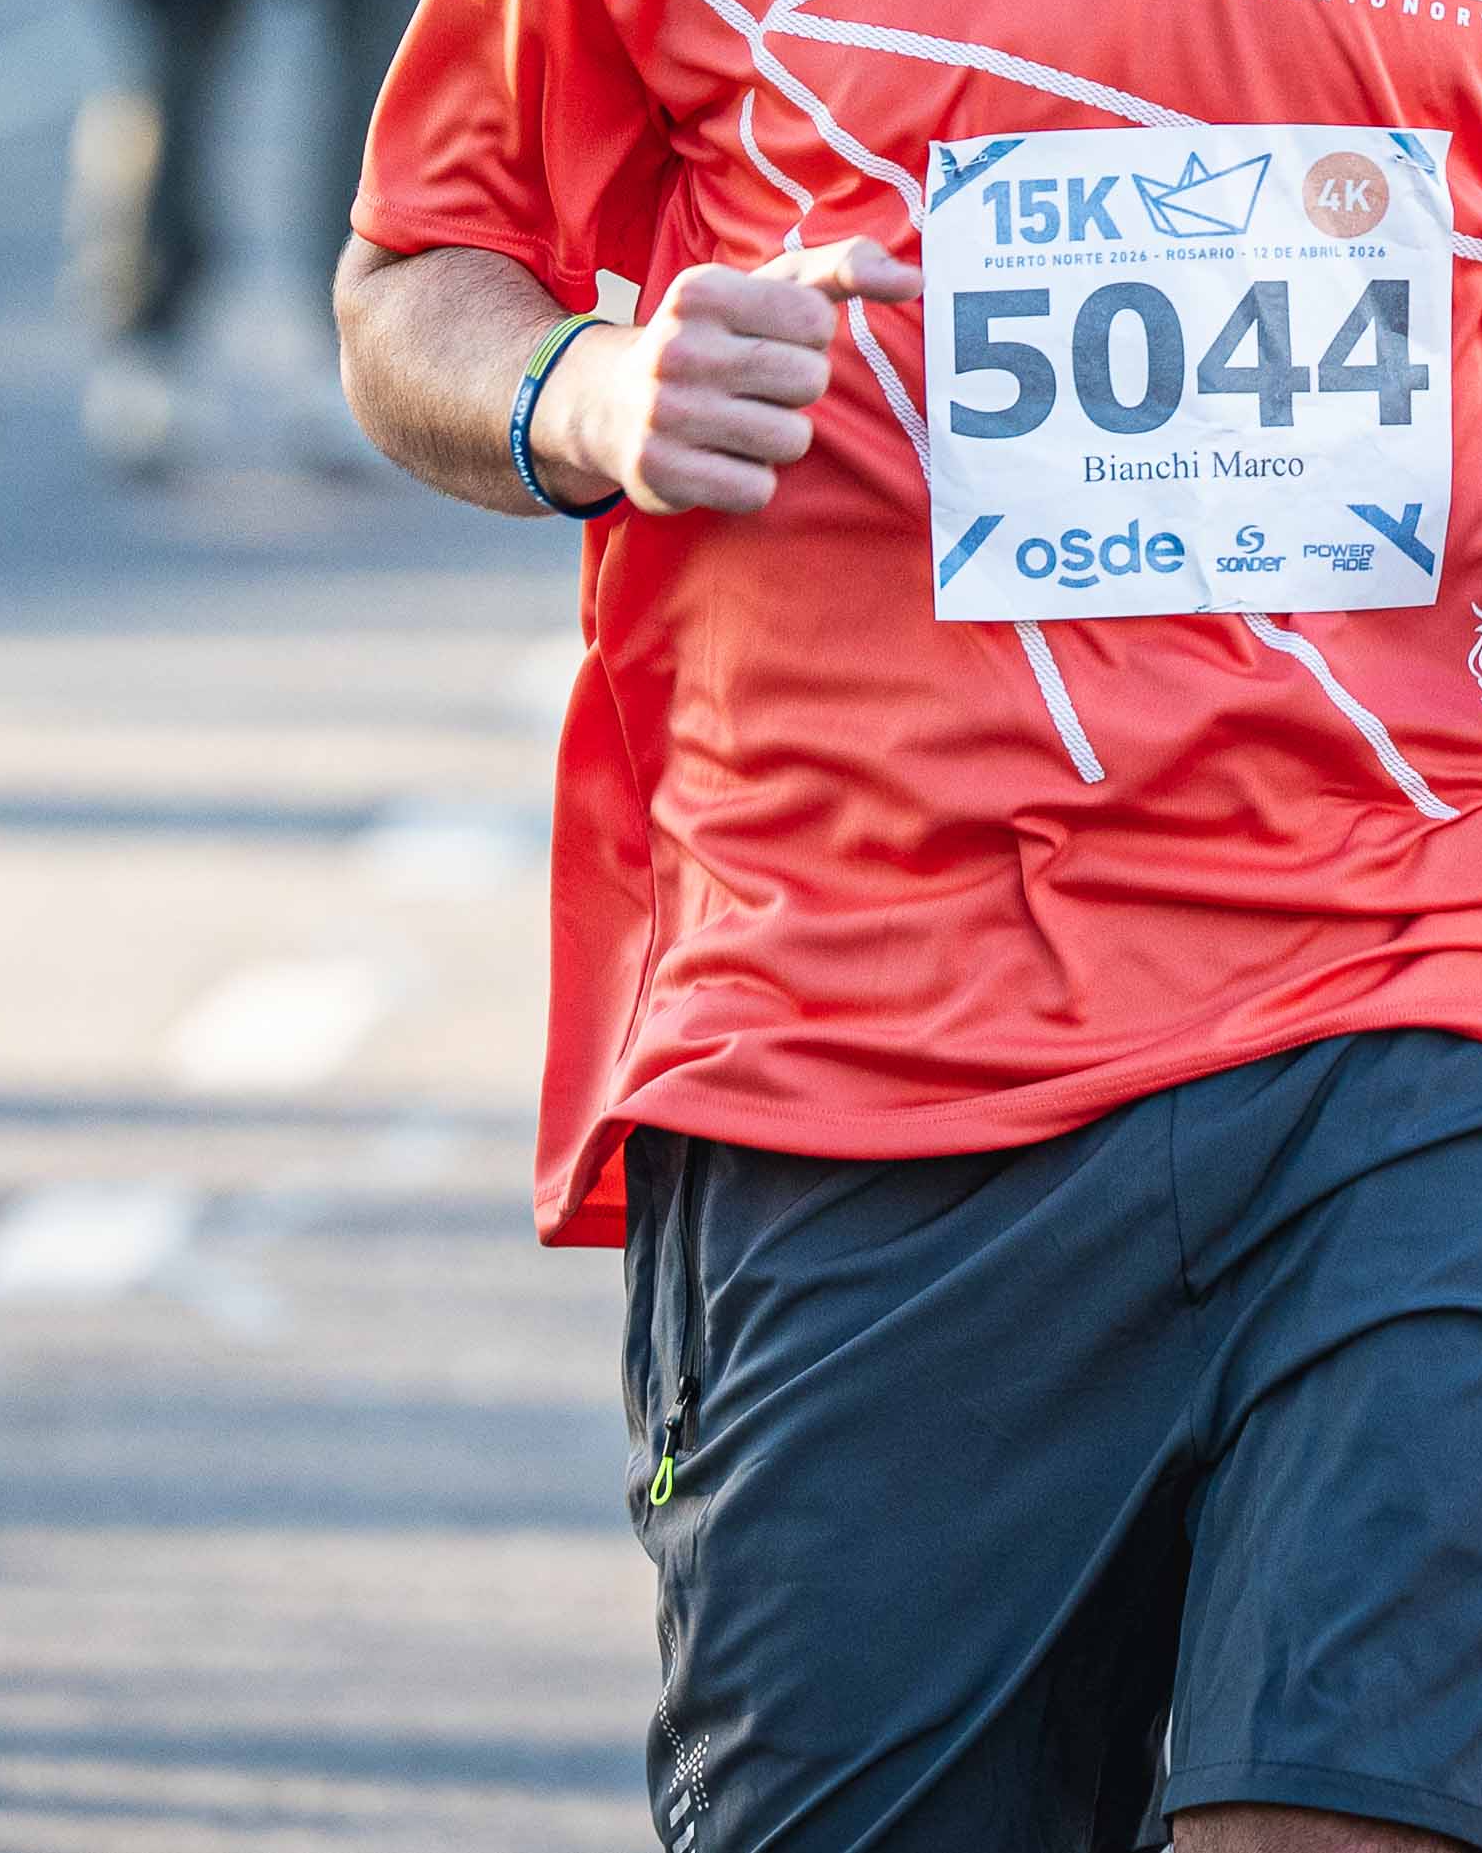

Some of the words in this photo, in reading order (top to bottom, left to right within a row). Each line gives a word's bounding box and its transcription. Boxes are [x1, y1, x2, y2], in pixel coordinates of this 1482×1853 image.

[982, 175, 1123, 245] 15K
[1316, 179, 1372, 212] 4K
[984, 254, 1046, 268] PUERTO
[1052, 252, 1103, 266] NORTE
[1110, 251, 1148, 264] 2026
[1166, 247, 1235, 260] ROSARIO
[1253, 247, 1267, 259] 12
[1274, 247, 1292, 259] DE
[1299, 246, 1342, 258] ABRIL
[1349, 246, 1386, 258] 2026
[949, 279, 1429, 439] 5044
[1084, 452, 1199, 483] Bianchi
[1213, 451, 1305, 479] Marco
[1016, 519, 1186, 580] osde
[1303, 544, 1375, 558] POWER
[1333, 558, 1371, 572] ADE
